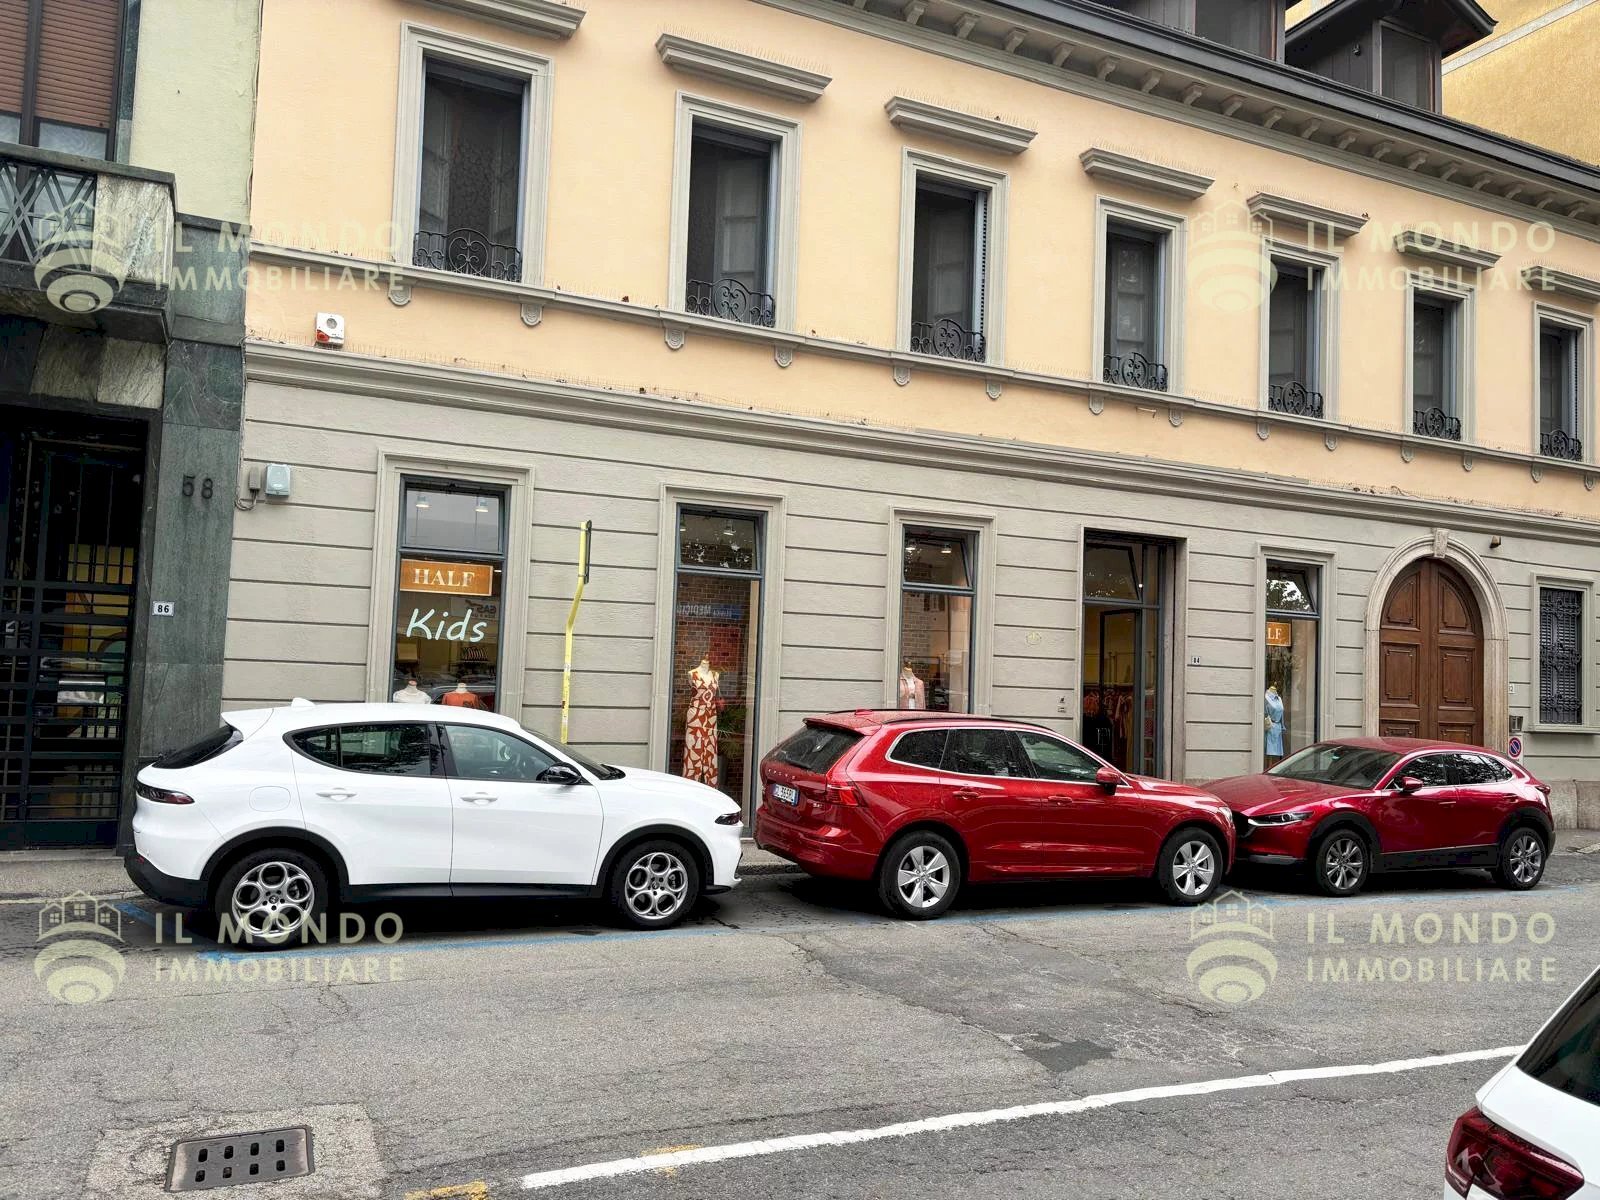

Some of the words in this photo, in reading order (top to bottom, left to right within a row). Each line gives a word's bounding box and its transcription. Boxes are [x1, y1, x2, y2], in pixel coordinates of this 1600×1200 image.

[182, 473, 214, 499] 58
[413, 568, 475, 587] HALF
[157, 604, 170, 614] 86
[406, 608, 488, 643] Kids
[1267, 627, 1283, 640] LF
